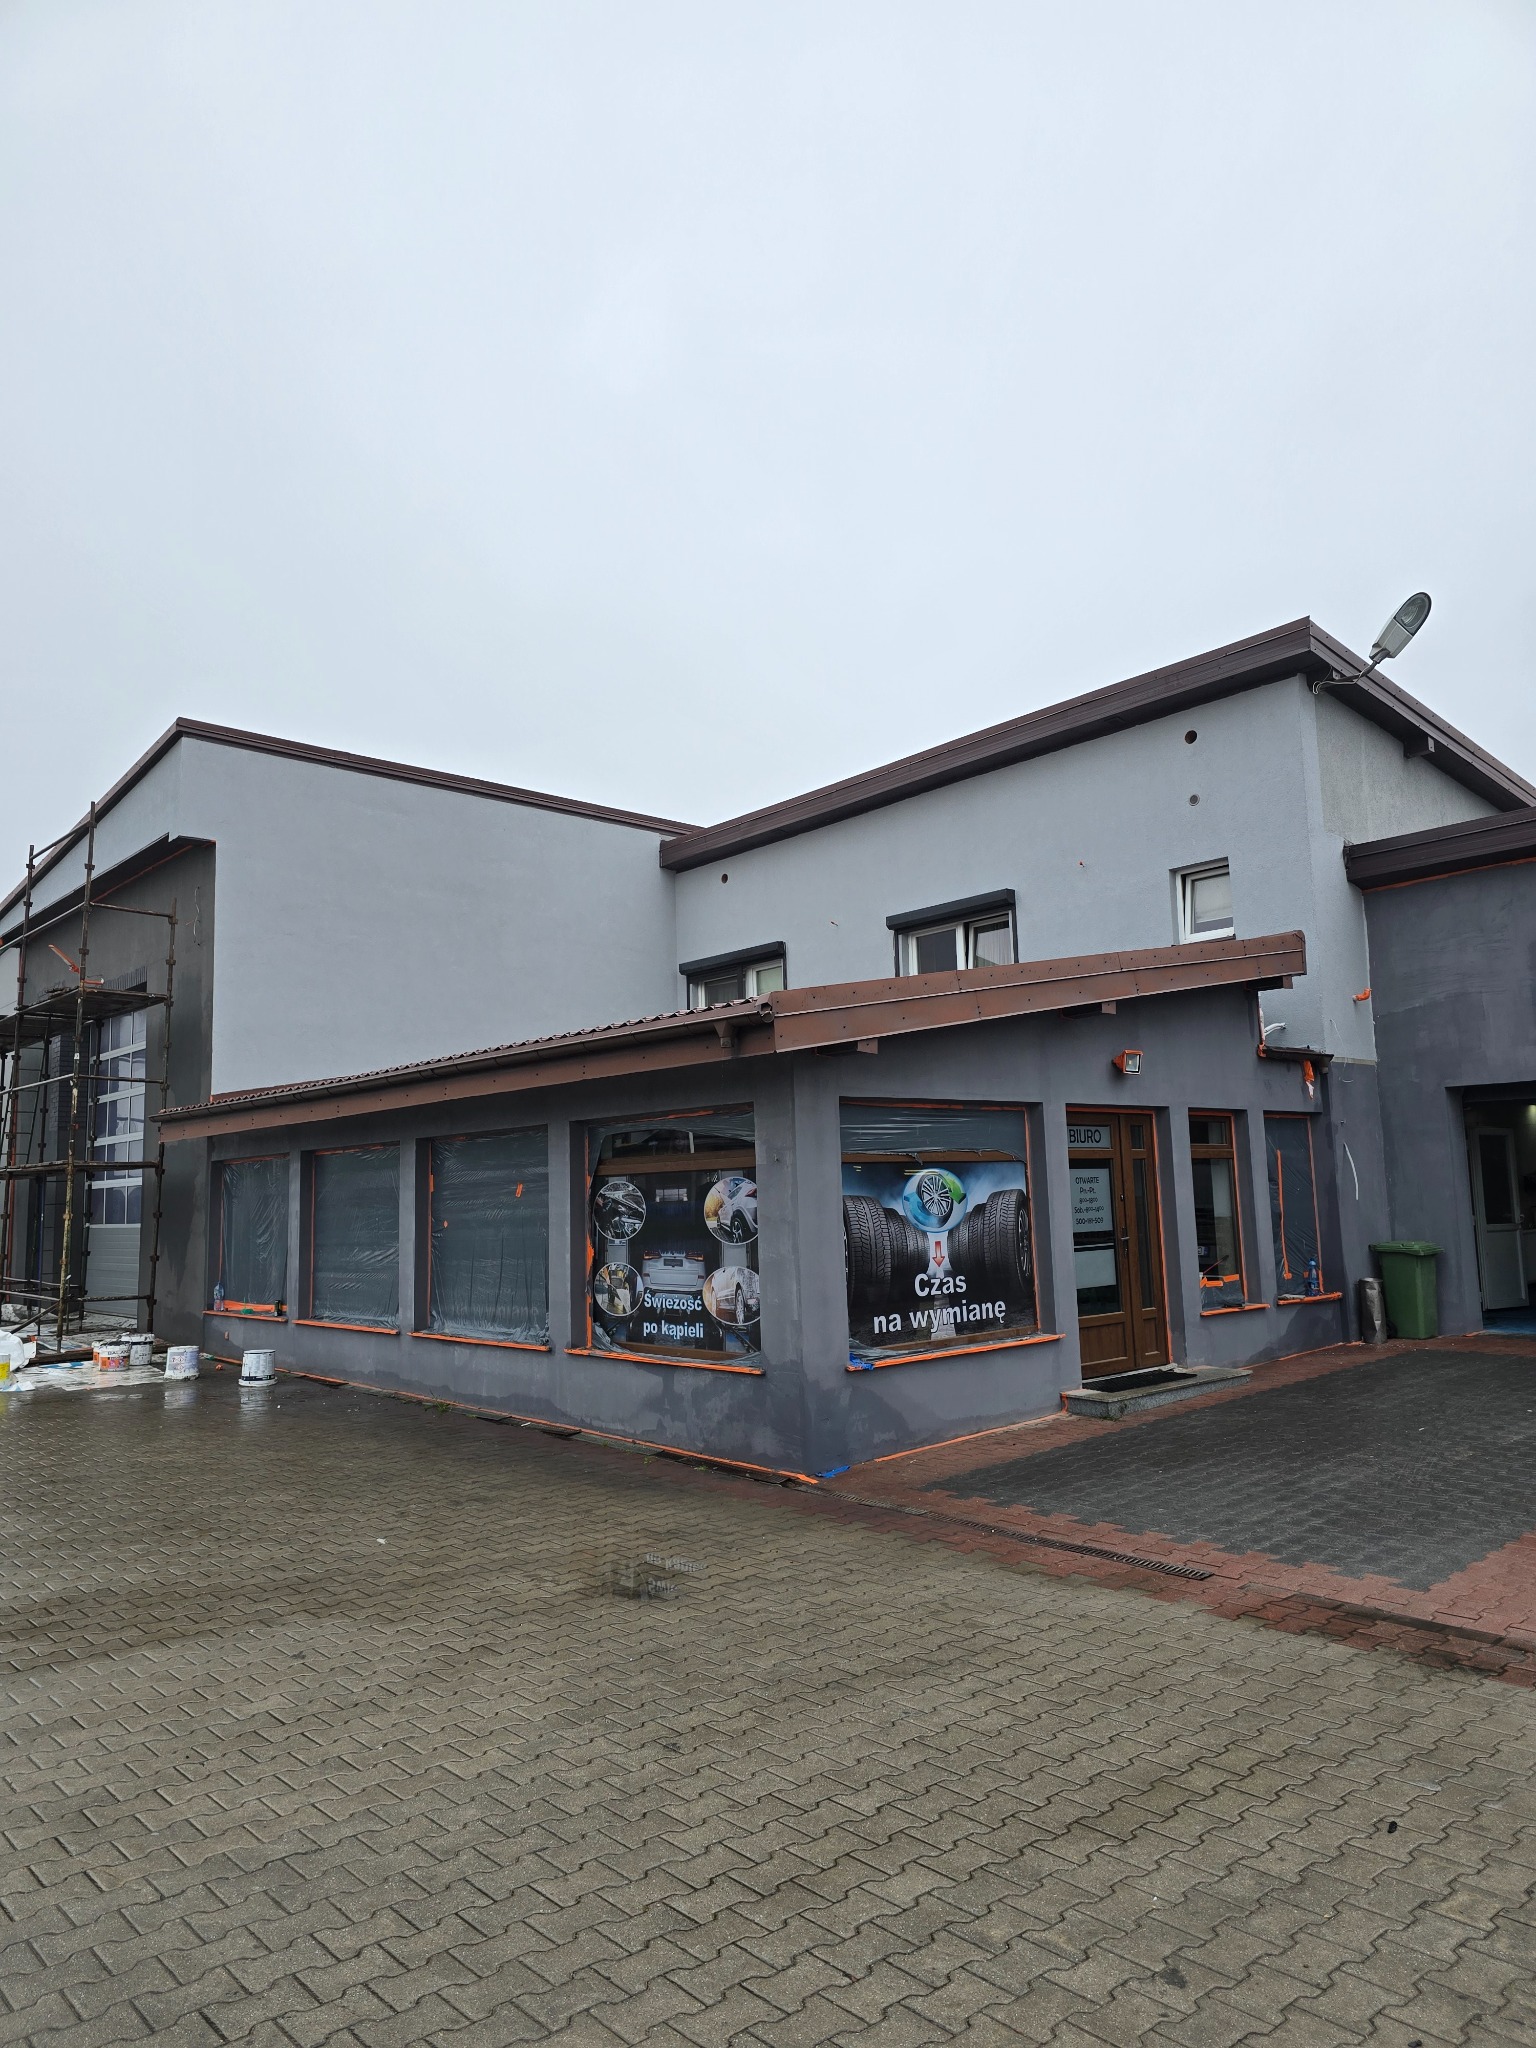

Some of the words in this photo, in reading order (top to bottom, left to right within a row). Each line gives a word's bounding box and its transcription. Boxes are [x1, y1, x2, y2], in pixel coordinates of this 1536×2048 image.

[1069, 1129, 1102, 1143] BIURO
[1075, 1176, 1100, 1185] OTWARTE
[914, 1273, 967, 1297] Czas
[643, 1289, 703, 1311] Świeżość
[873, 1313, 902, 1334] na
[909, 1299, 1007, 1333] wymianę
[643, 1322, 658, 1337] po
[661, 1319, 704, 1340] kąpieli
